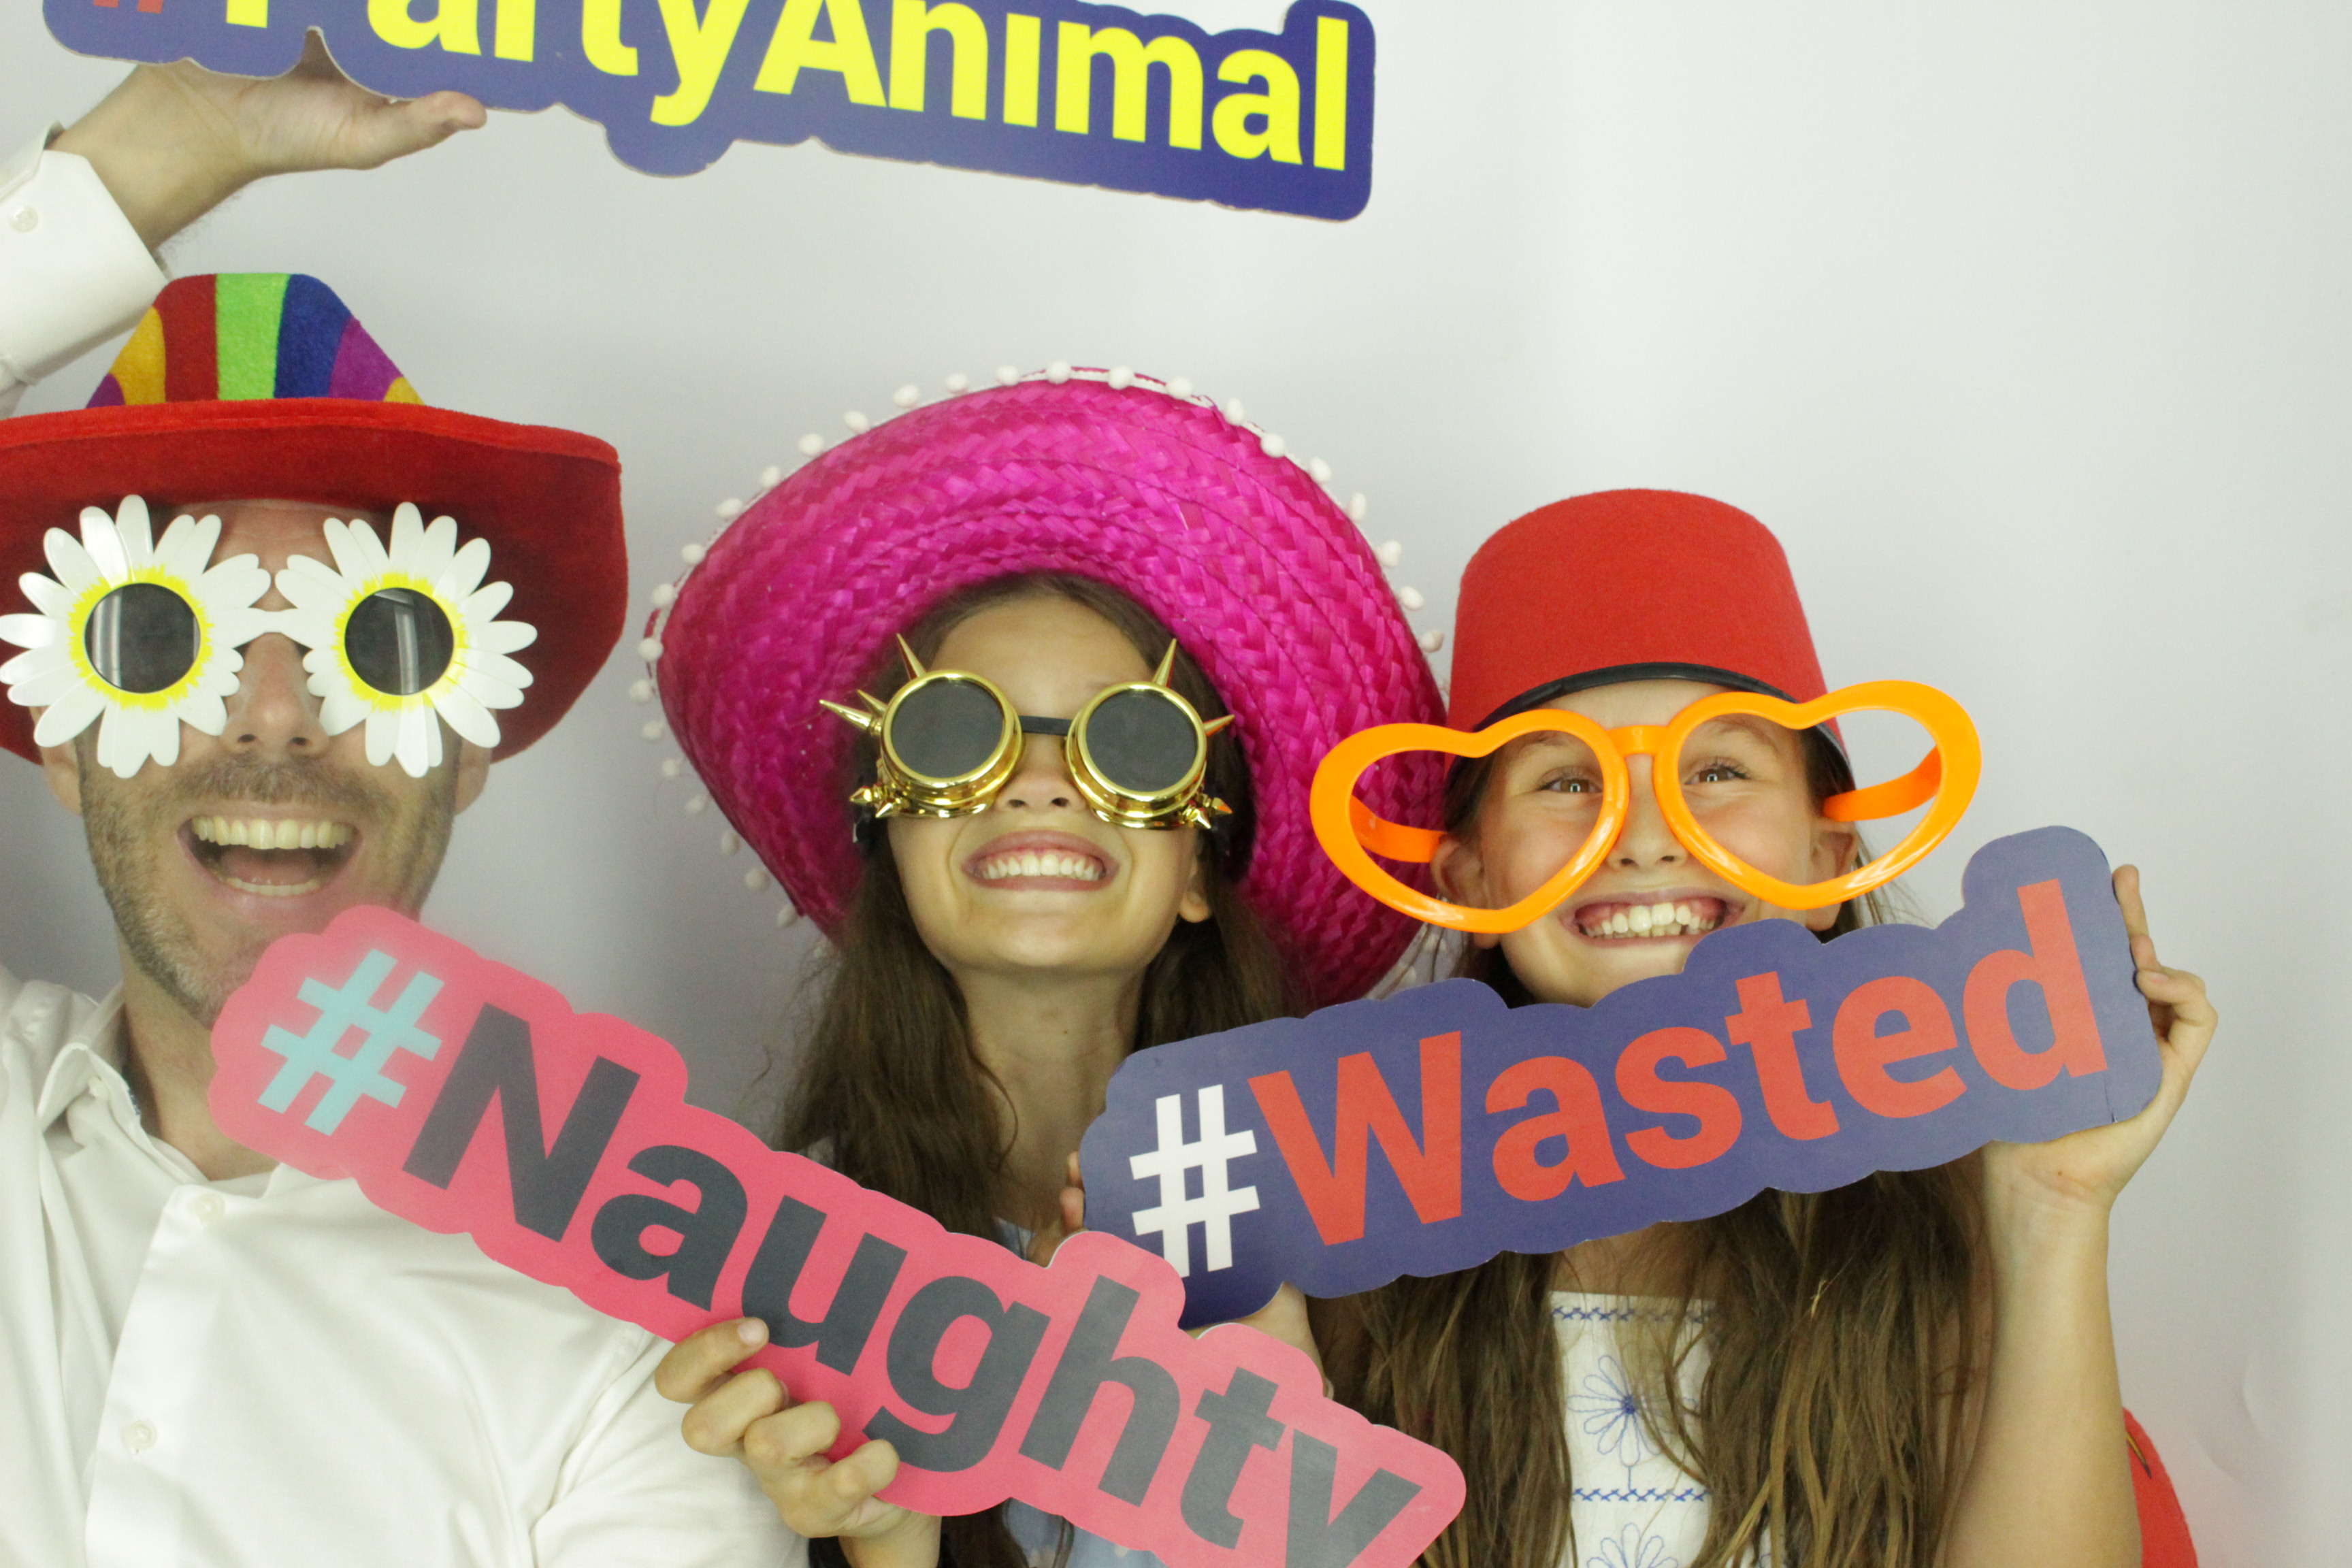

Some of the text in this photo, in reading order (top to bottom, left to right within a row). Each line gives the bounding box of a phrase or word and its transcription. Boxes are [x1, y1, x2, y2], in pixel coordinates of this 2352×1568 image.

[92, 0, 1350, 171] yAnimal
[256, 947, 1424, 1568] #Naughty
[1128, 878, 2108, 1277] #Wasted
